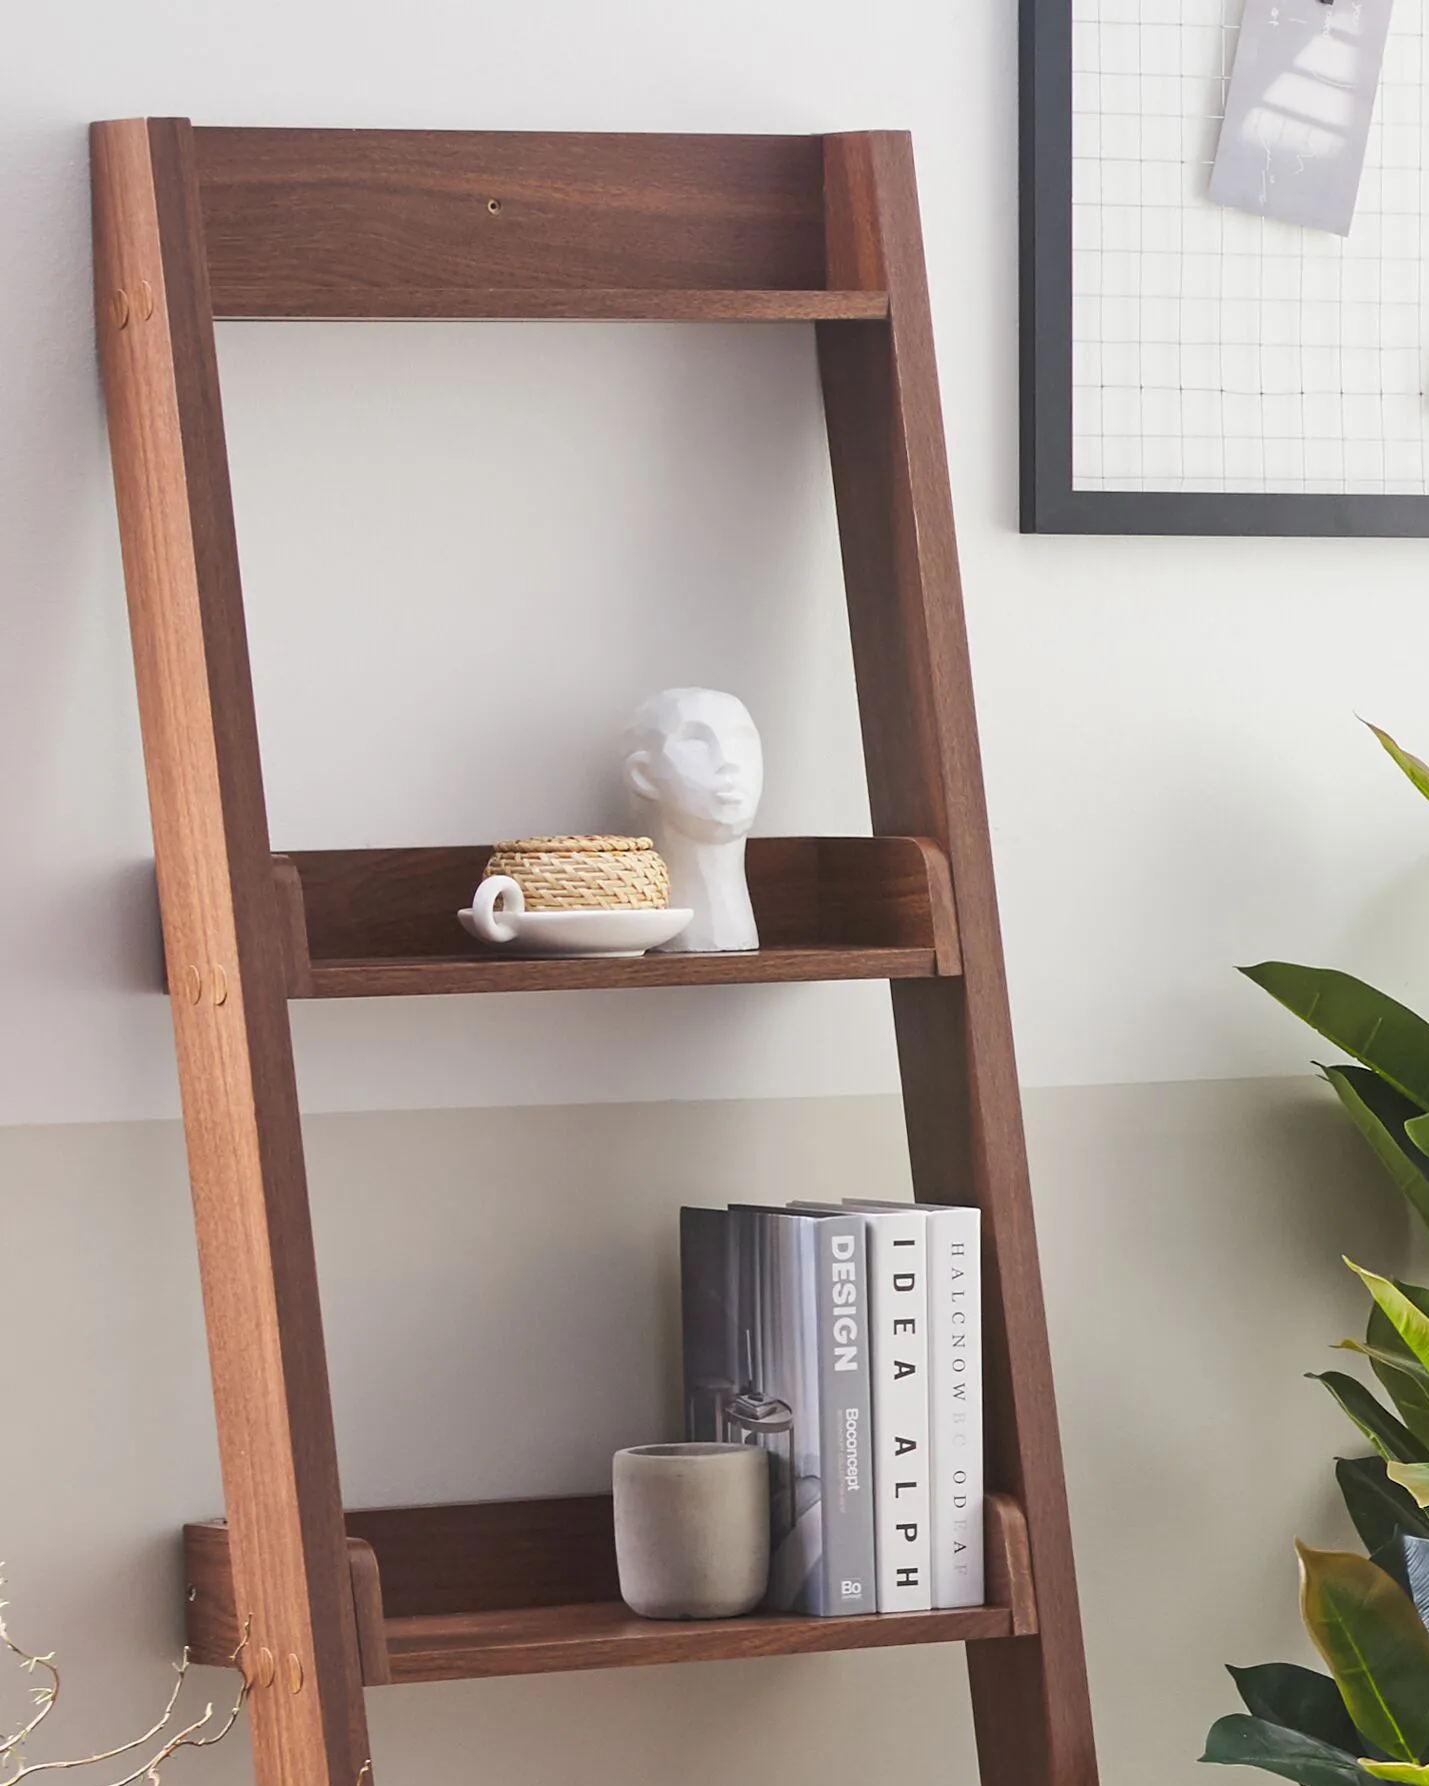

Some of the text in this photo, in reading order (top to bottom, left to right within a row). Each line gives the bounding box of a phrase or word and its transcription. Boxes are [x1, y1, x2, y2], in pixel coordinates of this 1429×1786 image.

[831, 1235, 858, 1371] DESIGN
[893, 1240, 916, 1380] IDEA
[845, 1407, 860, 1491] Boconcept
[895, 1436, 918, 1587] ALPH
[841, 1580, 862, 1595] Bo
